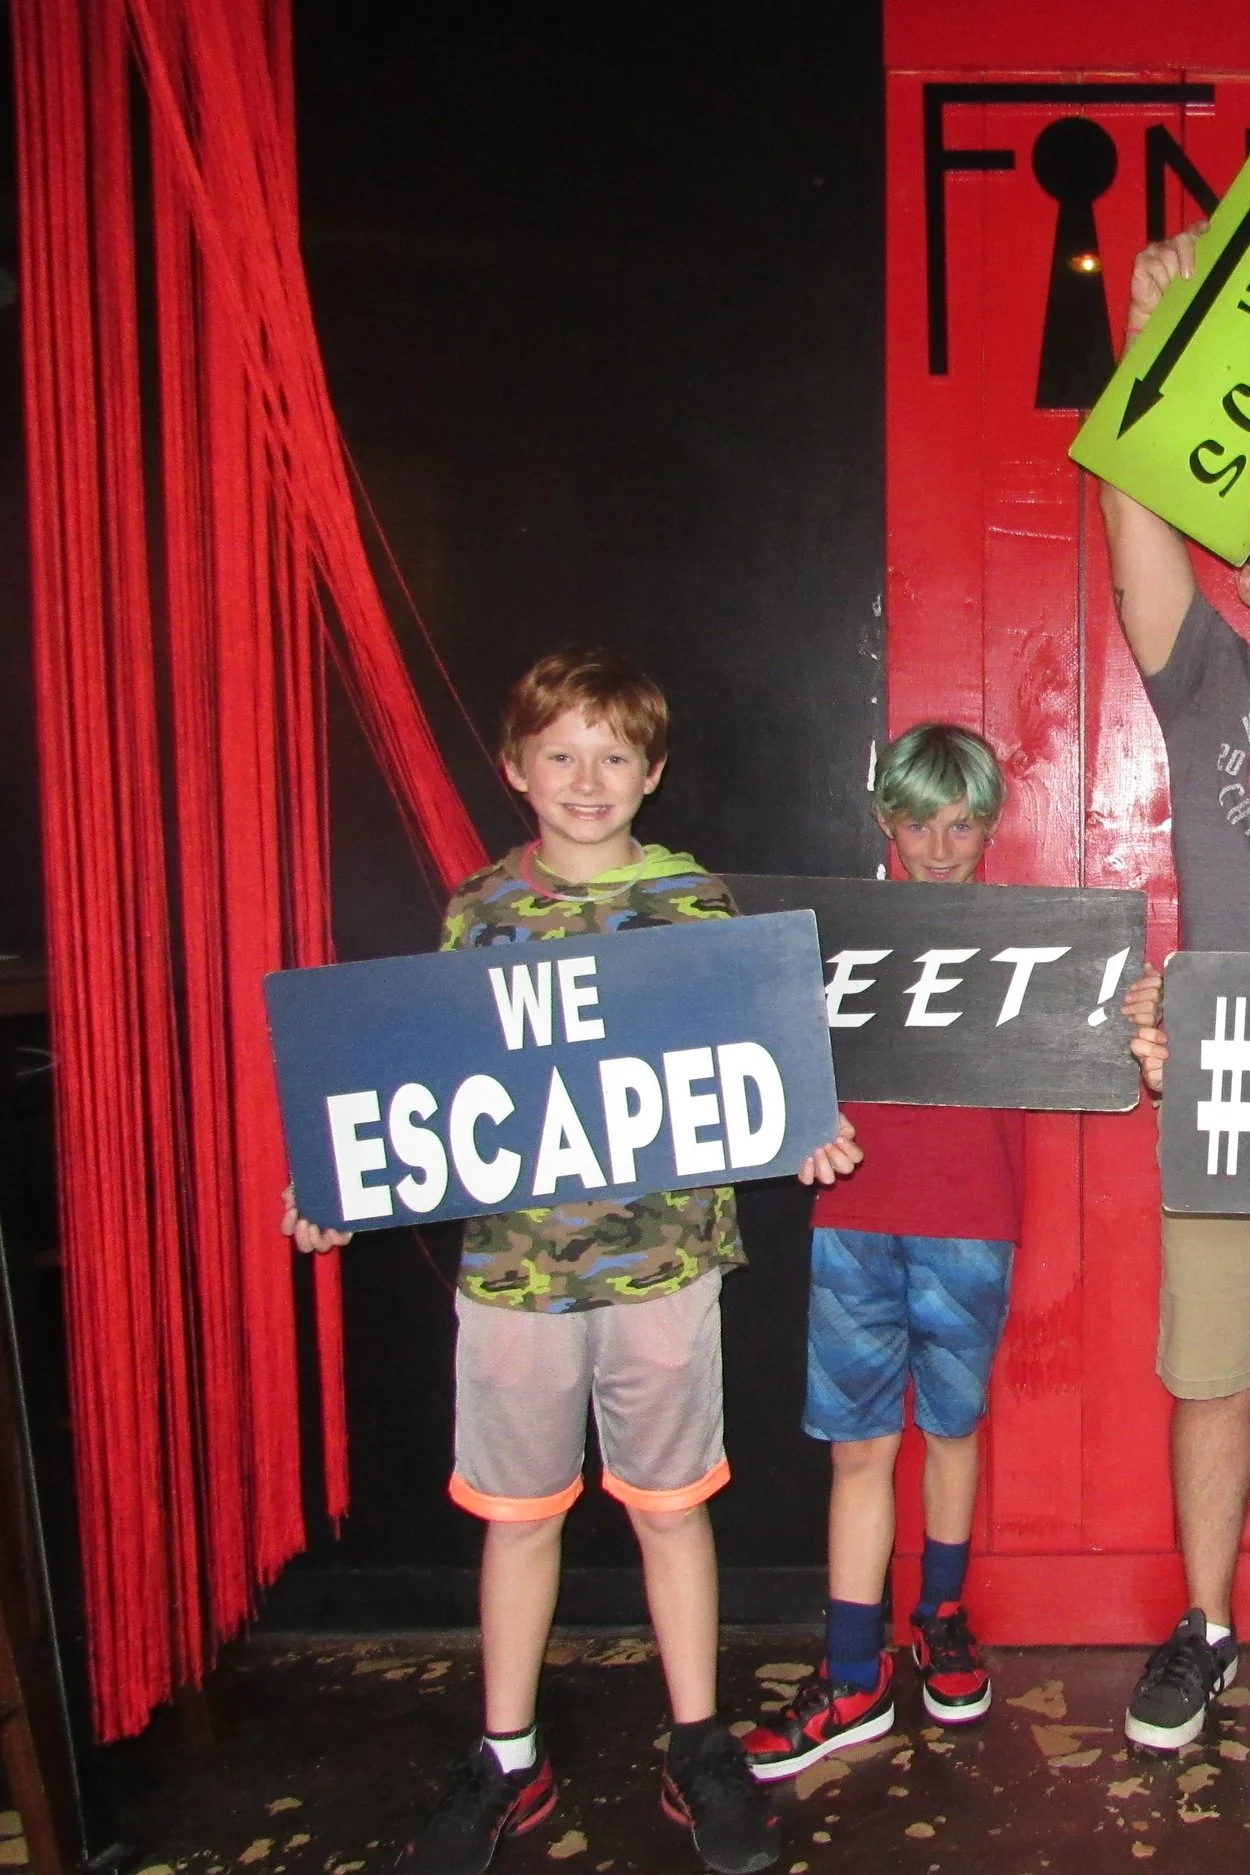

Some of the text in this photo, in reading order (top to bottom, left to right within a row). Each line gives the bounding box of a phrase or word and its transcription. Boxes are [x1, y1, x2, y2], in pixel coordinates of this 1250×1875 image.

[489, 956, 606, 1050] WE
[825, 946, 1130, 1028] EET!
[326, 1042, 786, 1221] ESCAPED
